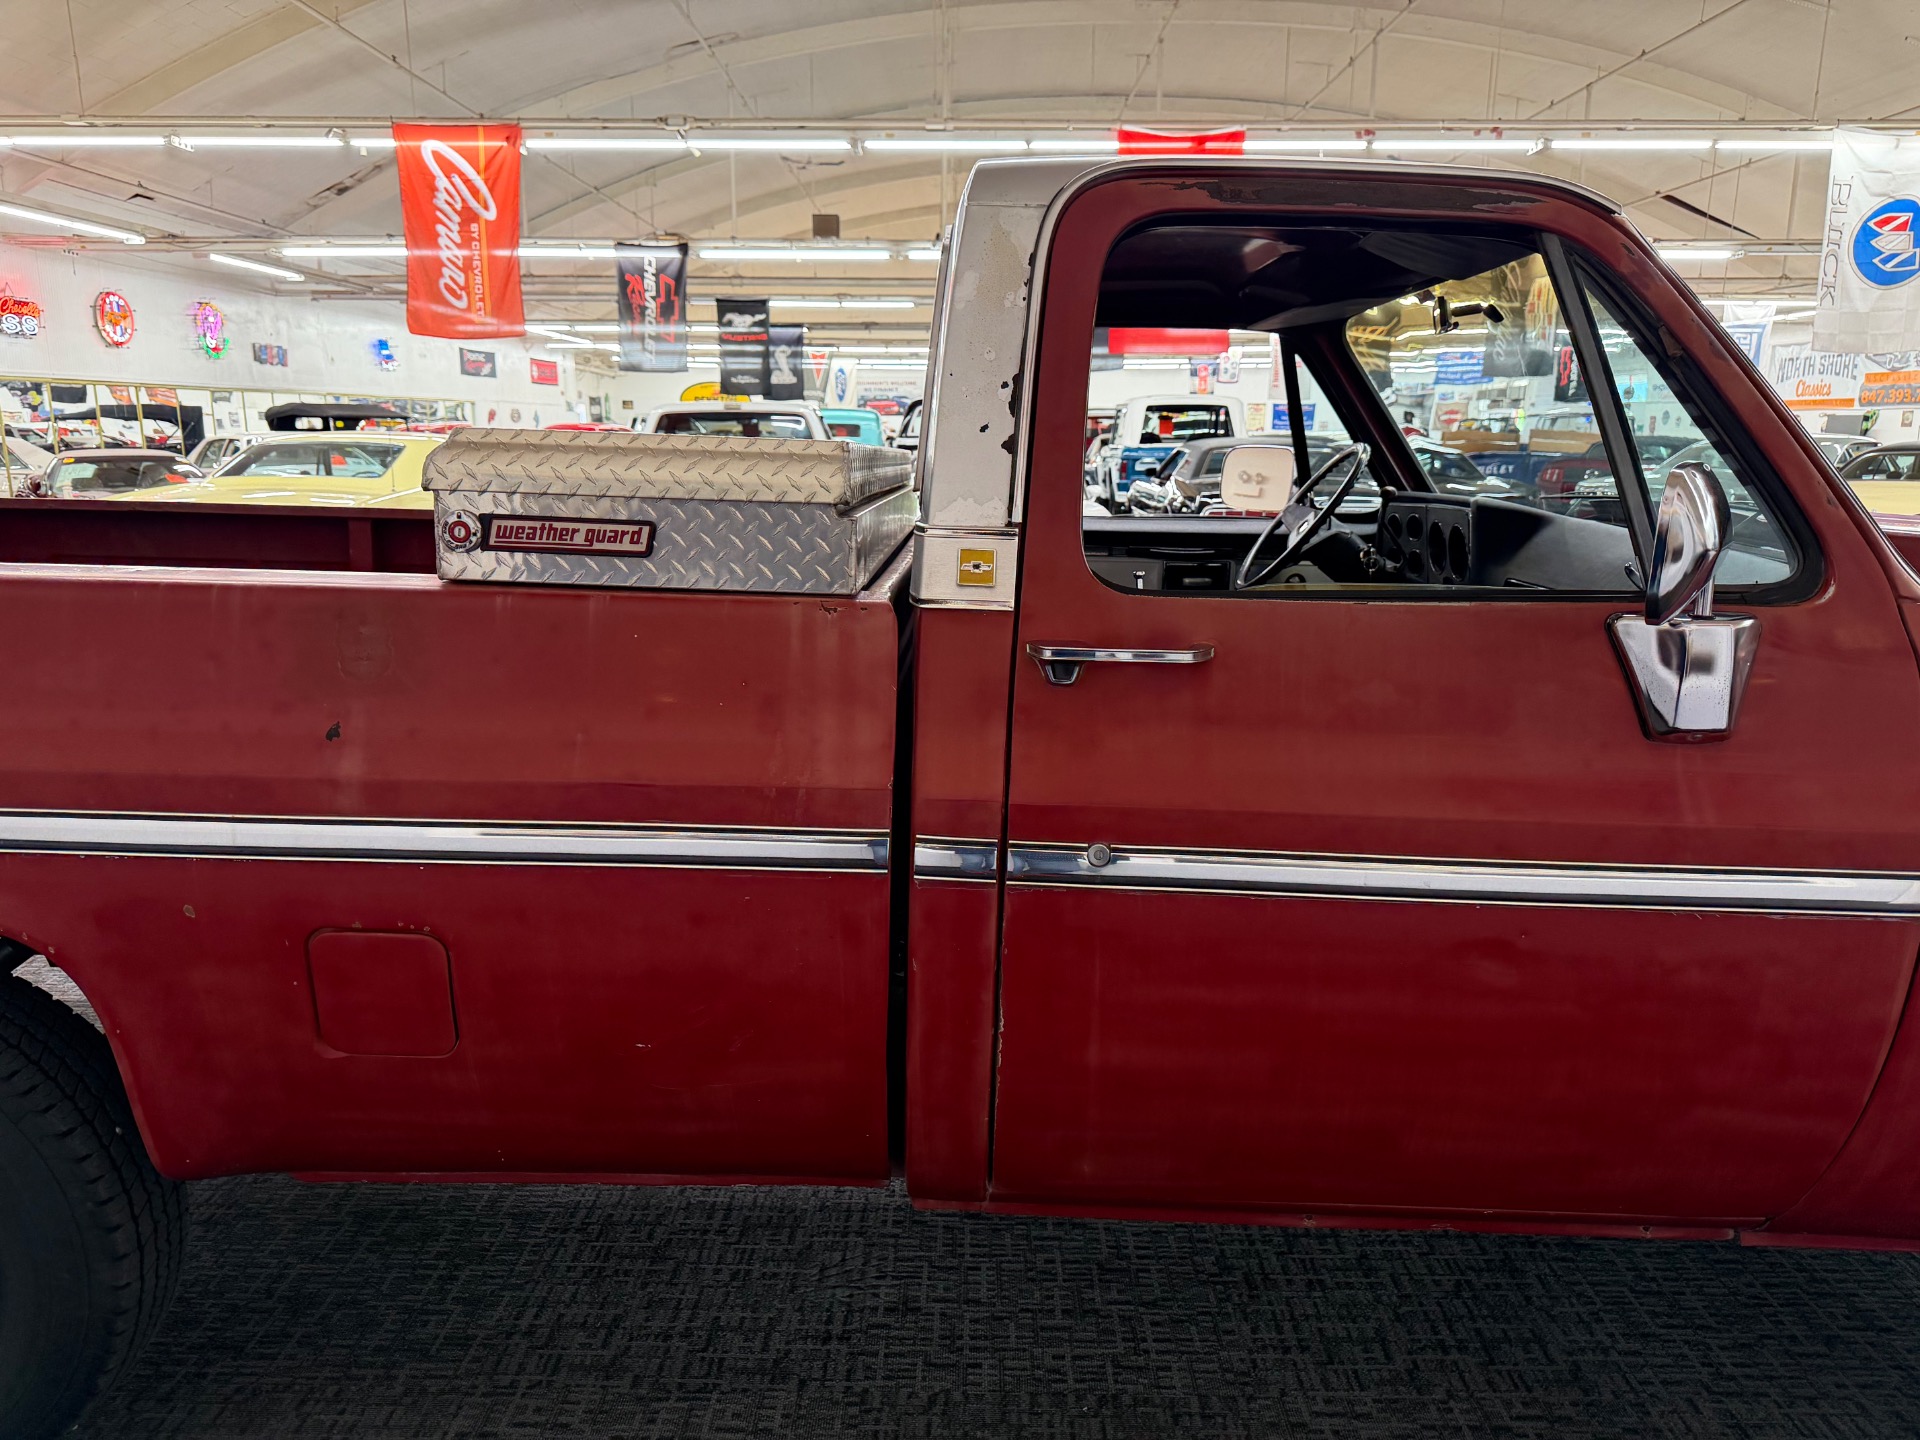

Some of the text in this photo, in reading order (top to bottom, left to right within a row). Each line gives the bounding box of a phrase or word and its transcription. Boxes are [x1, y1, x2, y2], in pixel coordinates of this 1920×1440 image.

[421, 139, 497, 309] Camaro
[1820, 175, 1853, 306] BUICK
[470, 223, 485, 318] BY CHEVROLET
[0, 314, 39, 335] SS
[643, 255, 657, 363] CHEVROLET
[1776, 352, 1858, 384] NORTH SHORE
[1795, 379, 1832, 397] Classics
[495, 523, 581, 542] weather
